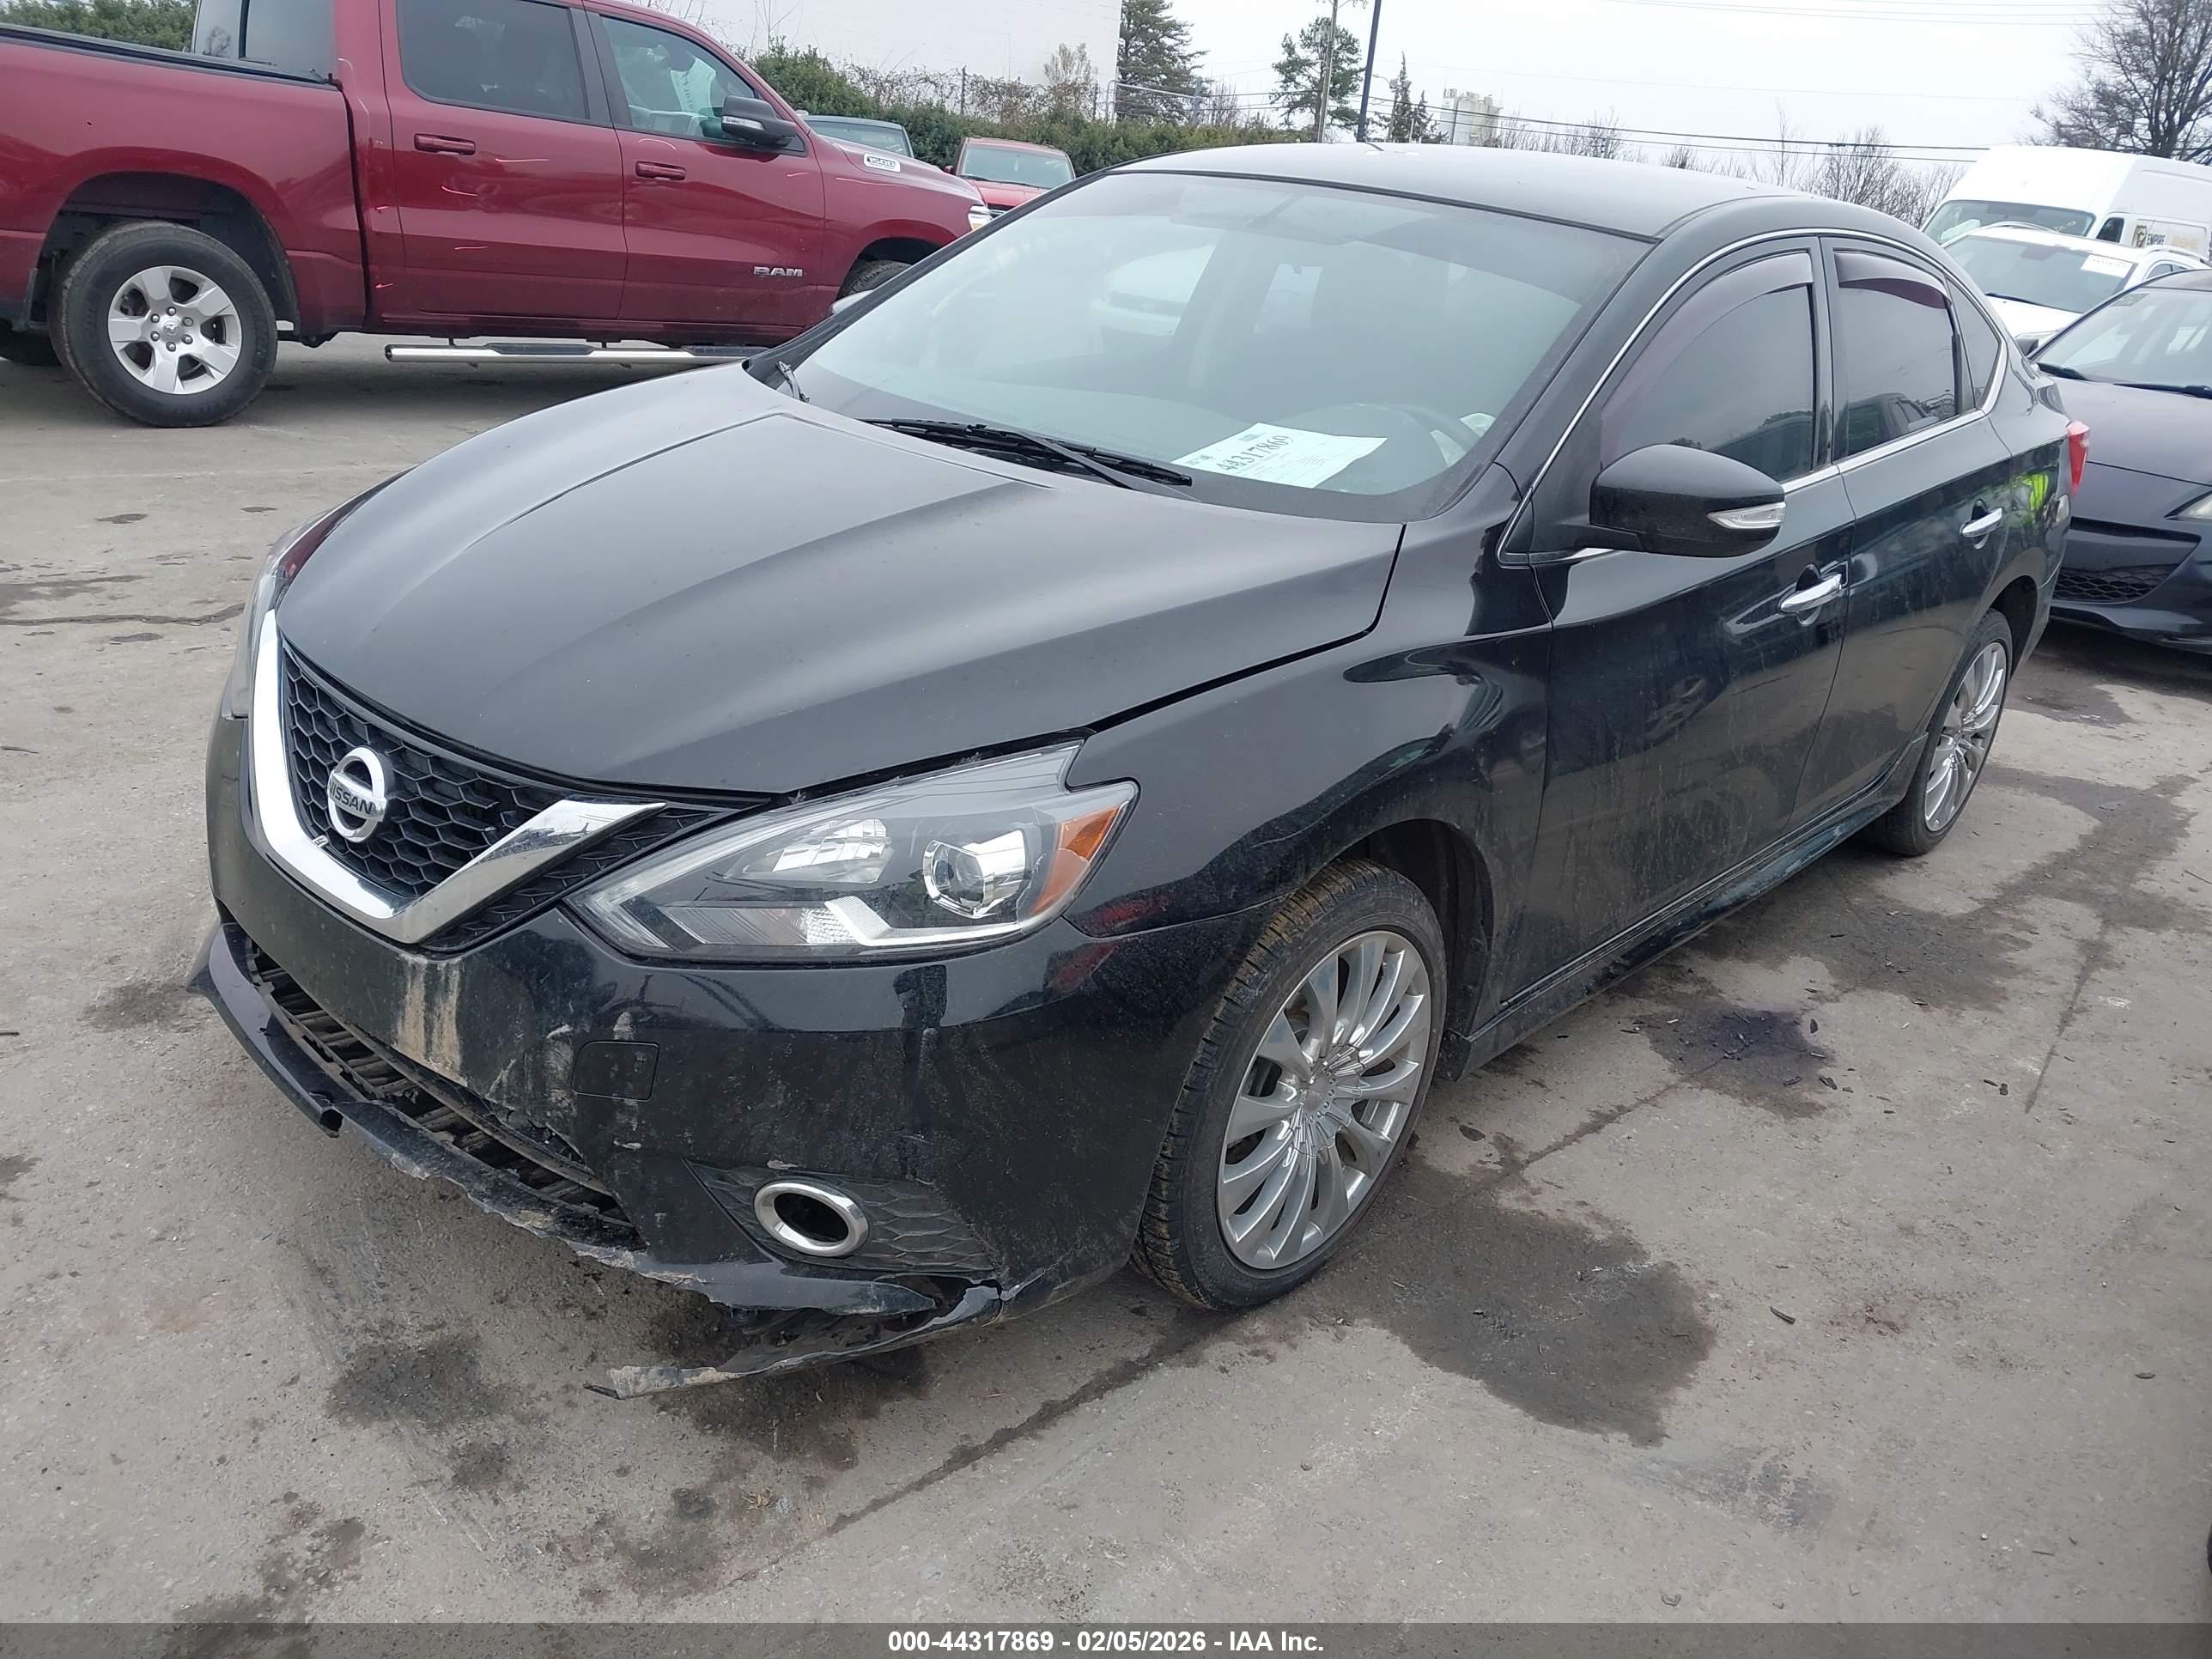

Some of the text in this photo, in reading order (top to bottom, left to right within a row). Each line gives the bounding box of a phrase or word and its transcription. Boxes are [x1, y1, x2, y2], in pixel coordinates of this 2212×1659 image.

[2146, 233, 2166, 246] EMPIRE
[753, 265, 804, 277] RAM
[329, 779, 374, 815] NISSAN
